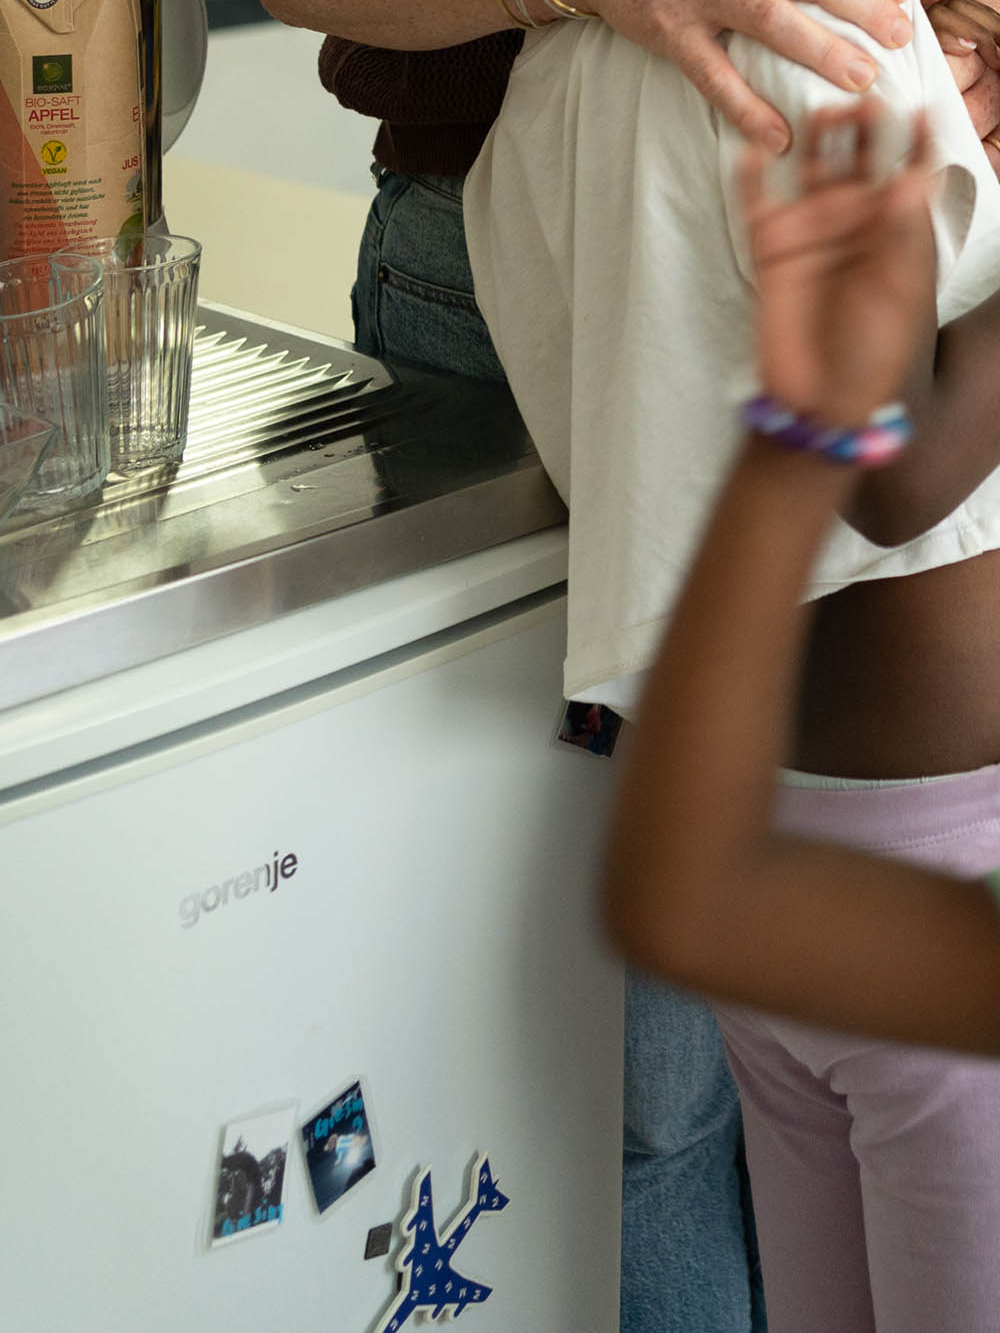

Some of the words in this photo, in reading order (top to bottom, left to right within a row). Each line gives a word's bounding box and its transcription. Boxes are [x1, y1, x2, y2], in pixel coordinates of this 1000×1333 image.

[25, 95, 81, 108] BIO-SAFT
[28, 108, 80, 123] APFEL
[122, 155, 139, 170] JUS
[41, 167, 67, 175] VEGAN
[179, 851, 299, 930] gorenje
